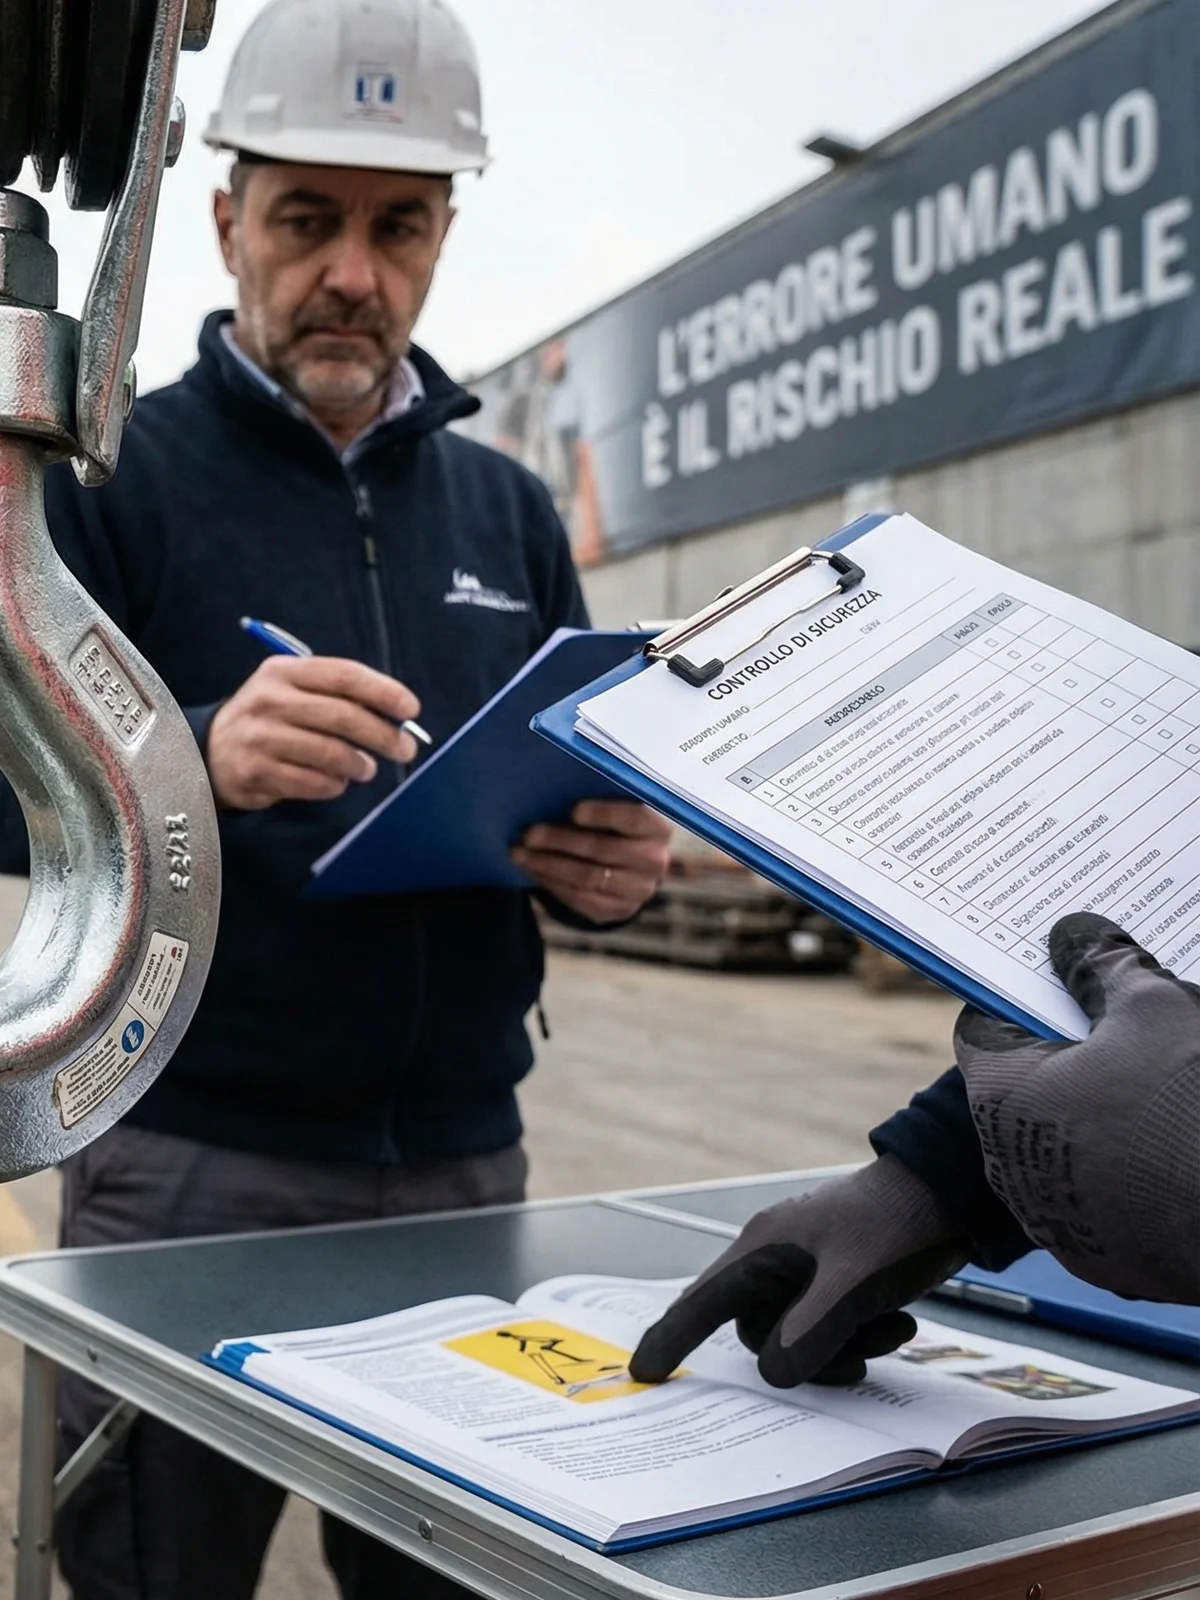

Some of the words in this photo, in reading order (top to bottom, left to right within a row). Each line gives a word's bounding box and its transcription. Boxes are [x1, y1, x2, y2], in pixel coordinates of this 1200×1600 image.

[656, 227, 878, 398] L'ERRORE
[891, 87, 1159, 291] UMANO
[641, 403, 674, 490] È
[678, 398, 721, 475] IL
[726, 305, 941, 460] RISCHIO
[957, 197, 1194, 375] REALE
[708, 645, 793, 699] CONTROLLO
[791, 633, 812, 648] DI
[809, 590, 881, 636] SICUREZZA
[763, 790, 775, 798] 1
[787, 804, 799, 813] 2
[810, 818, 823, 827] 3
[880, 860, 893, 870] 5
[912, 879, 925, 889] 6
[939, 896, 951, 906] 7
[966, 914, 980, 924] 8
[994, 932, 1006, 942] 9
[1022, 949, 1037, 961] 10
